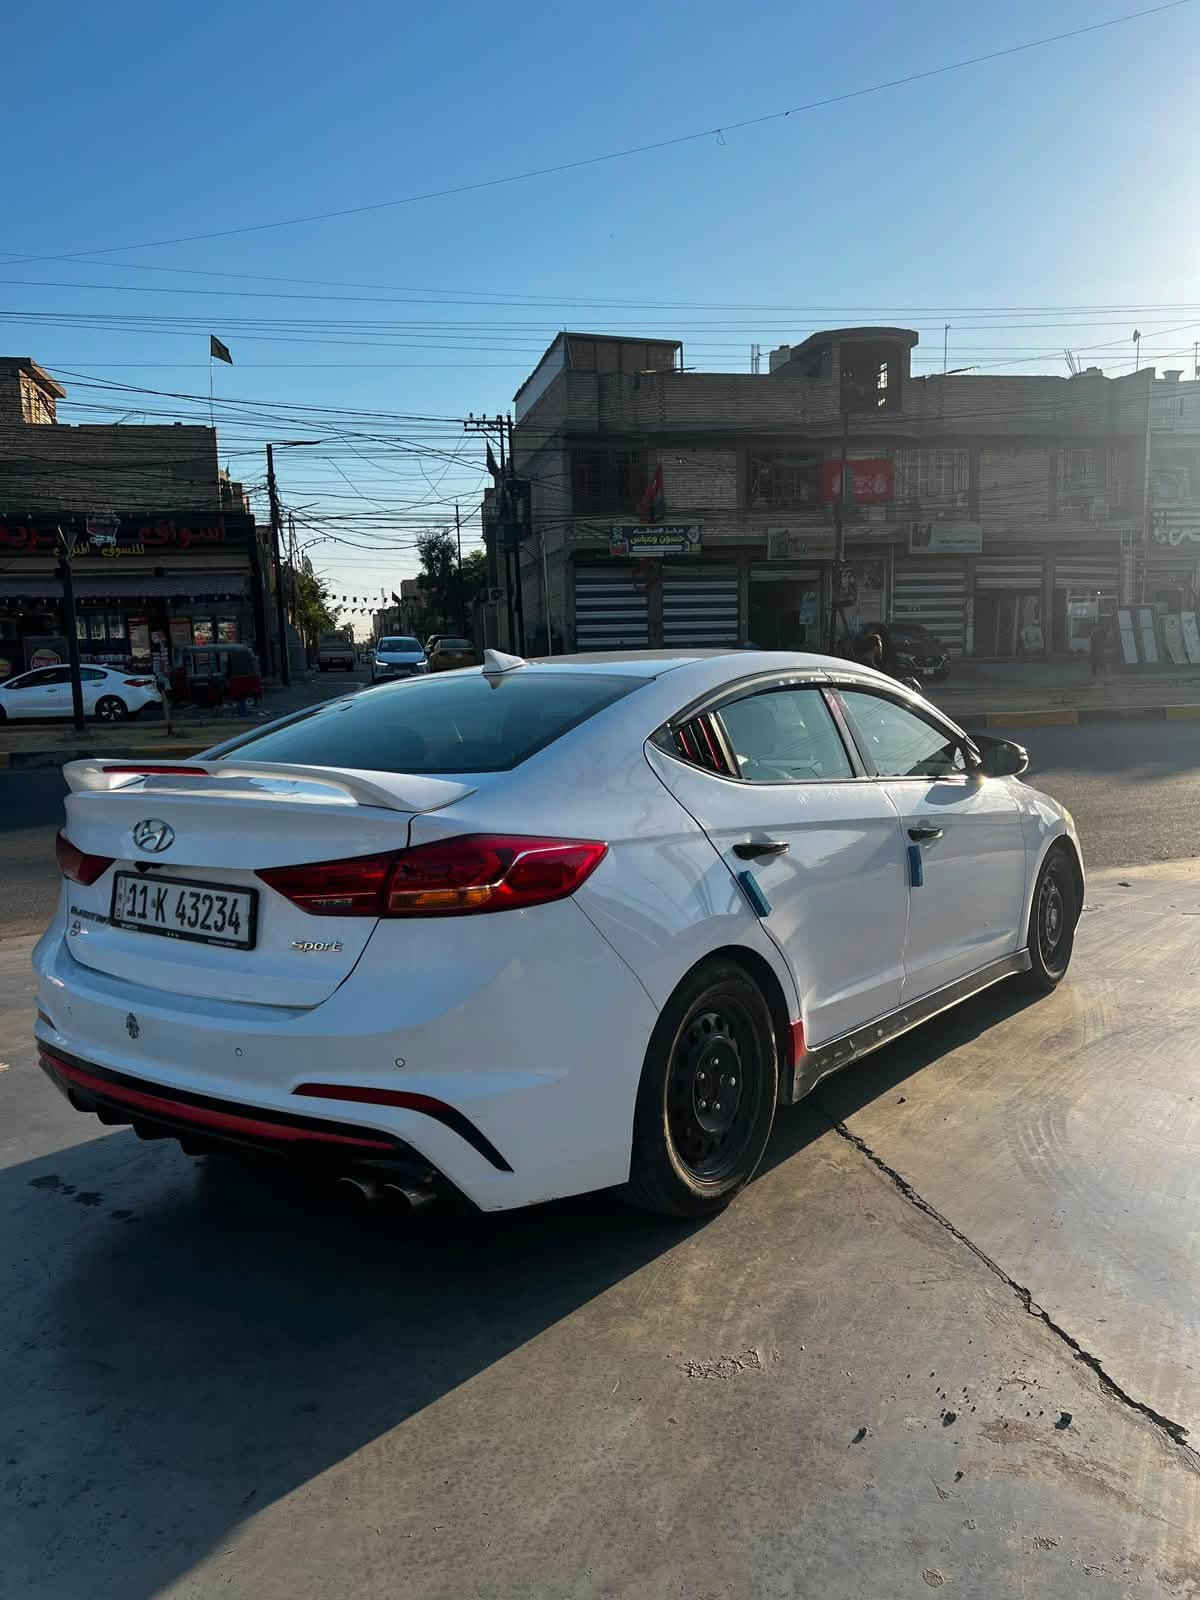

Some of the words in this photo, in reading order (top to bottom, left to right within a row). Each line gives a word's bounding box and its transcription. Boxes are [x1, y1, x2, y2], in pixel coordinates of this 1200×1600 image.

[127, 883, 148, 919] 11
[155, 887, 168, 923] K
[176, 890, 240, 935] 43234
